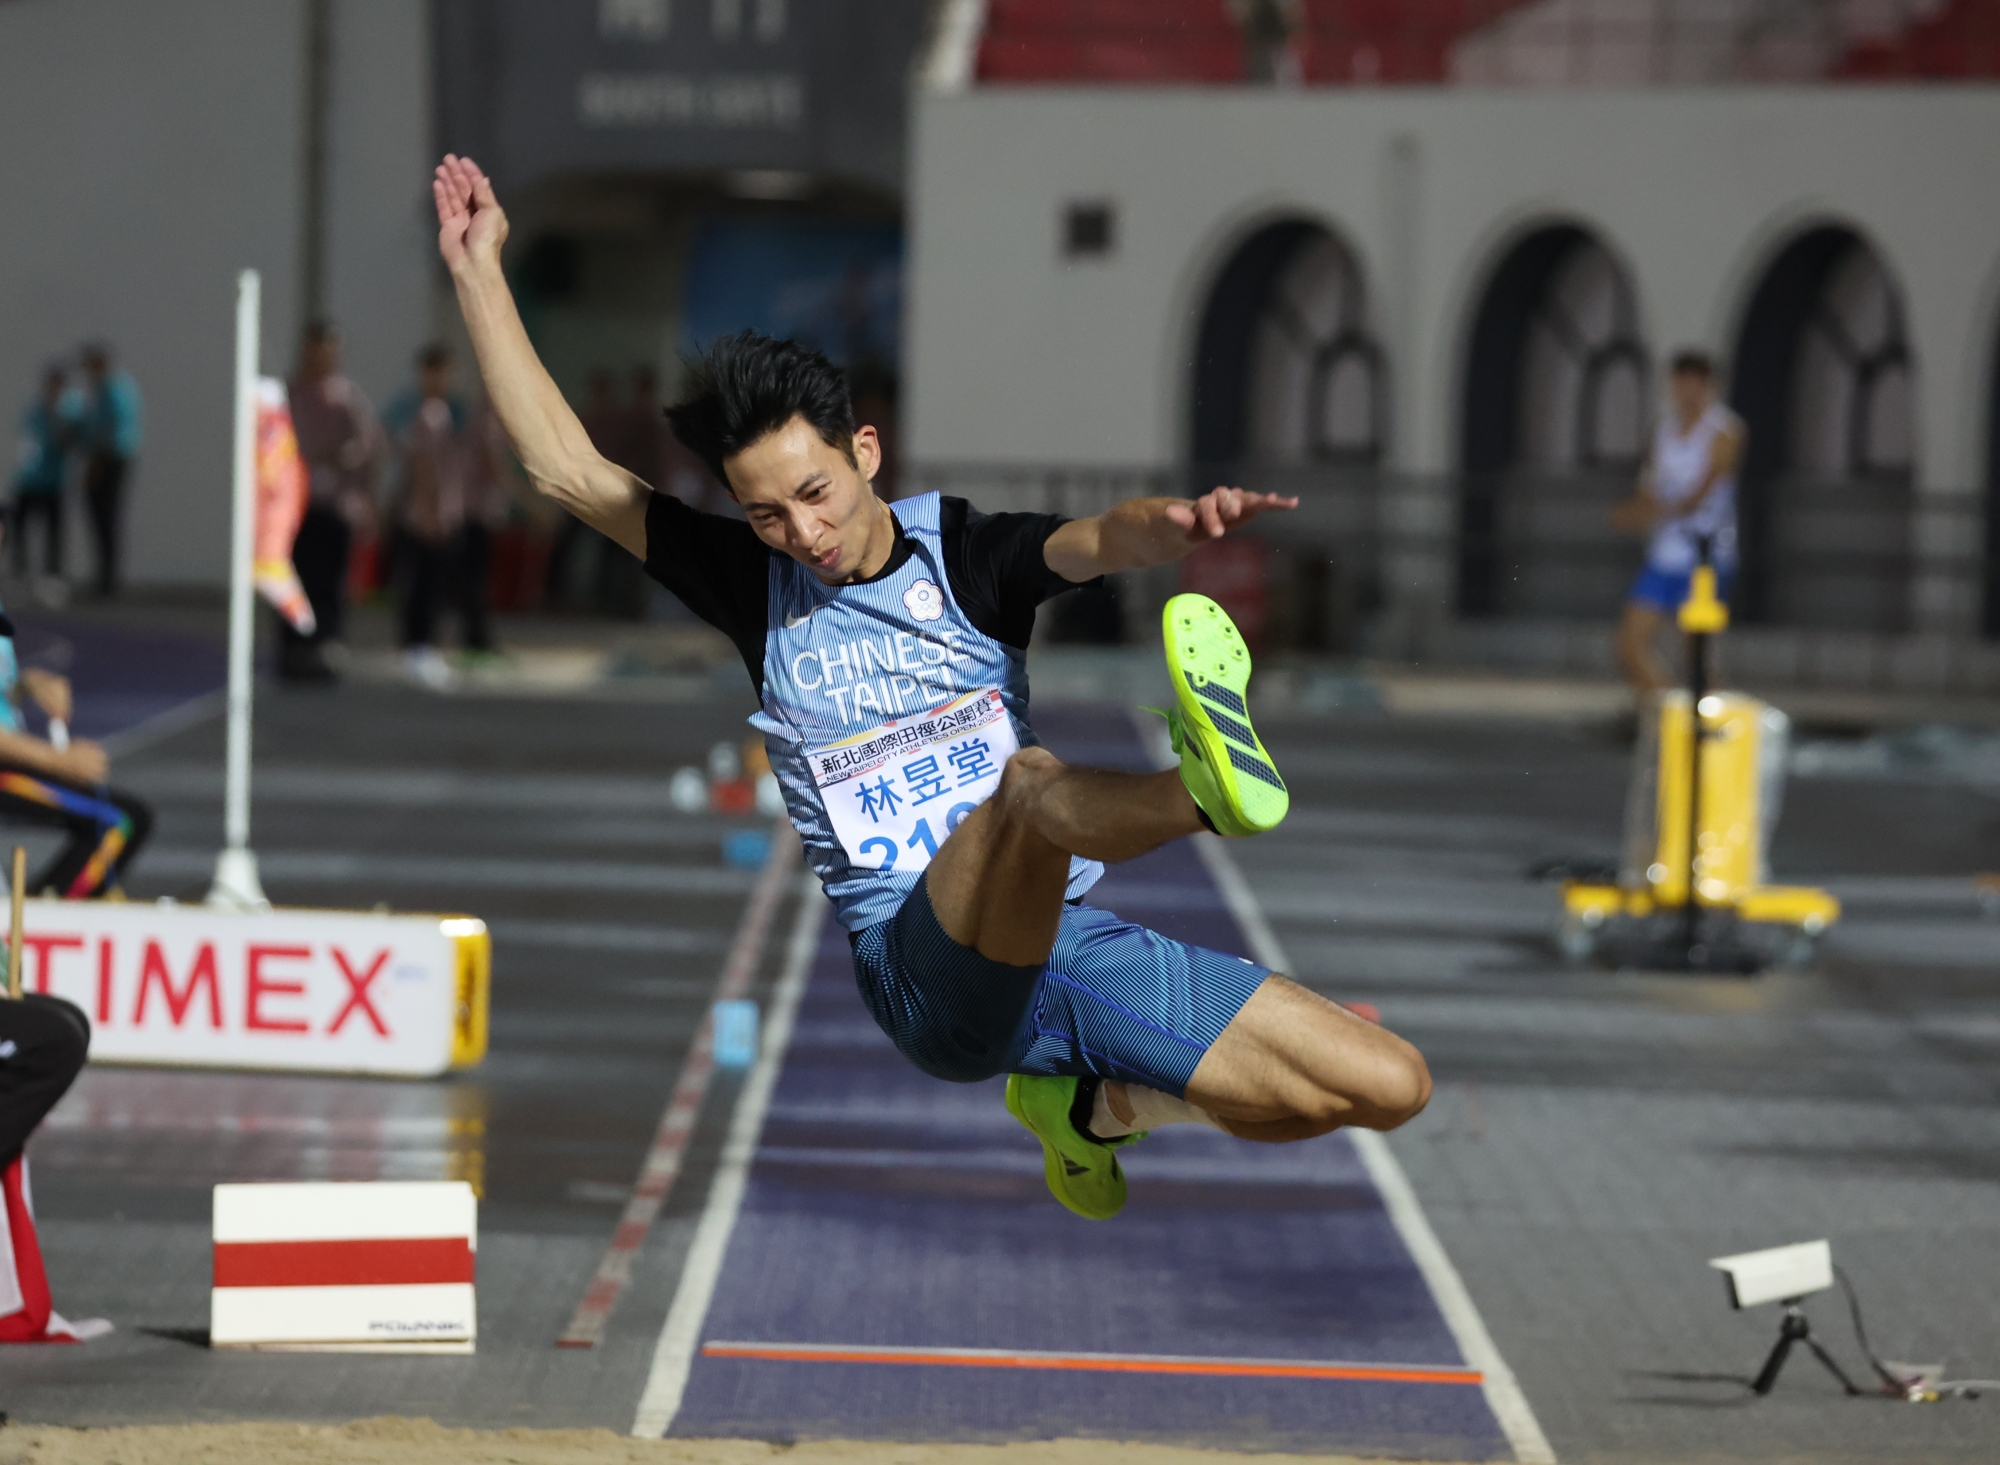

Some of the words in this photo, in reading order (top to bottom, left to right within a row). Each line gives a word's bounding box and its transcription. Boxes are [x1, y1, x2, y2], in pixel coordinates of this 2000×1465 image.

[792, 630, 970, 691] CHINESE
[825, 665, 956, 725] TAIPEI
[821, 695, 993, 775] 新北國際田徑公開賽
[826, 770, 849, 783] NEW
[849, 760, 877, 776] TAIPEI
[876, 751, 898, 766] CITY
[899, 732, 949, 755] ATHLETICS
[950, 722, 977, 735] OPEN
[855, 737, 999, 823] 林昱堂
[6, 930, 392, 1040] TIMEX
